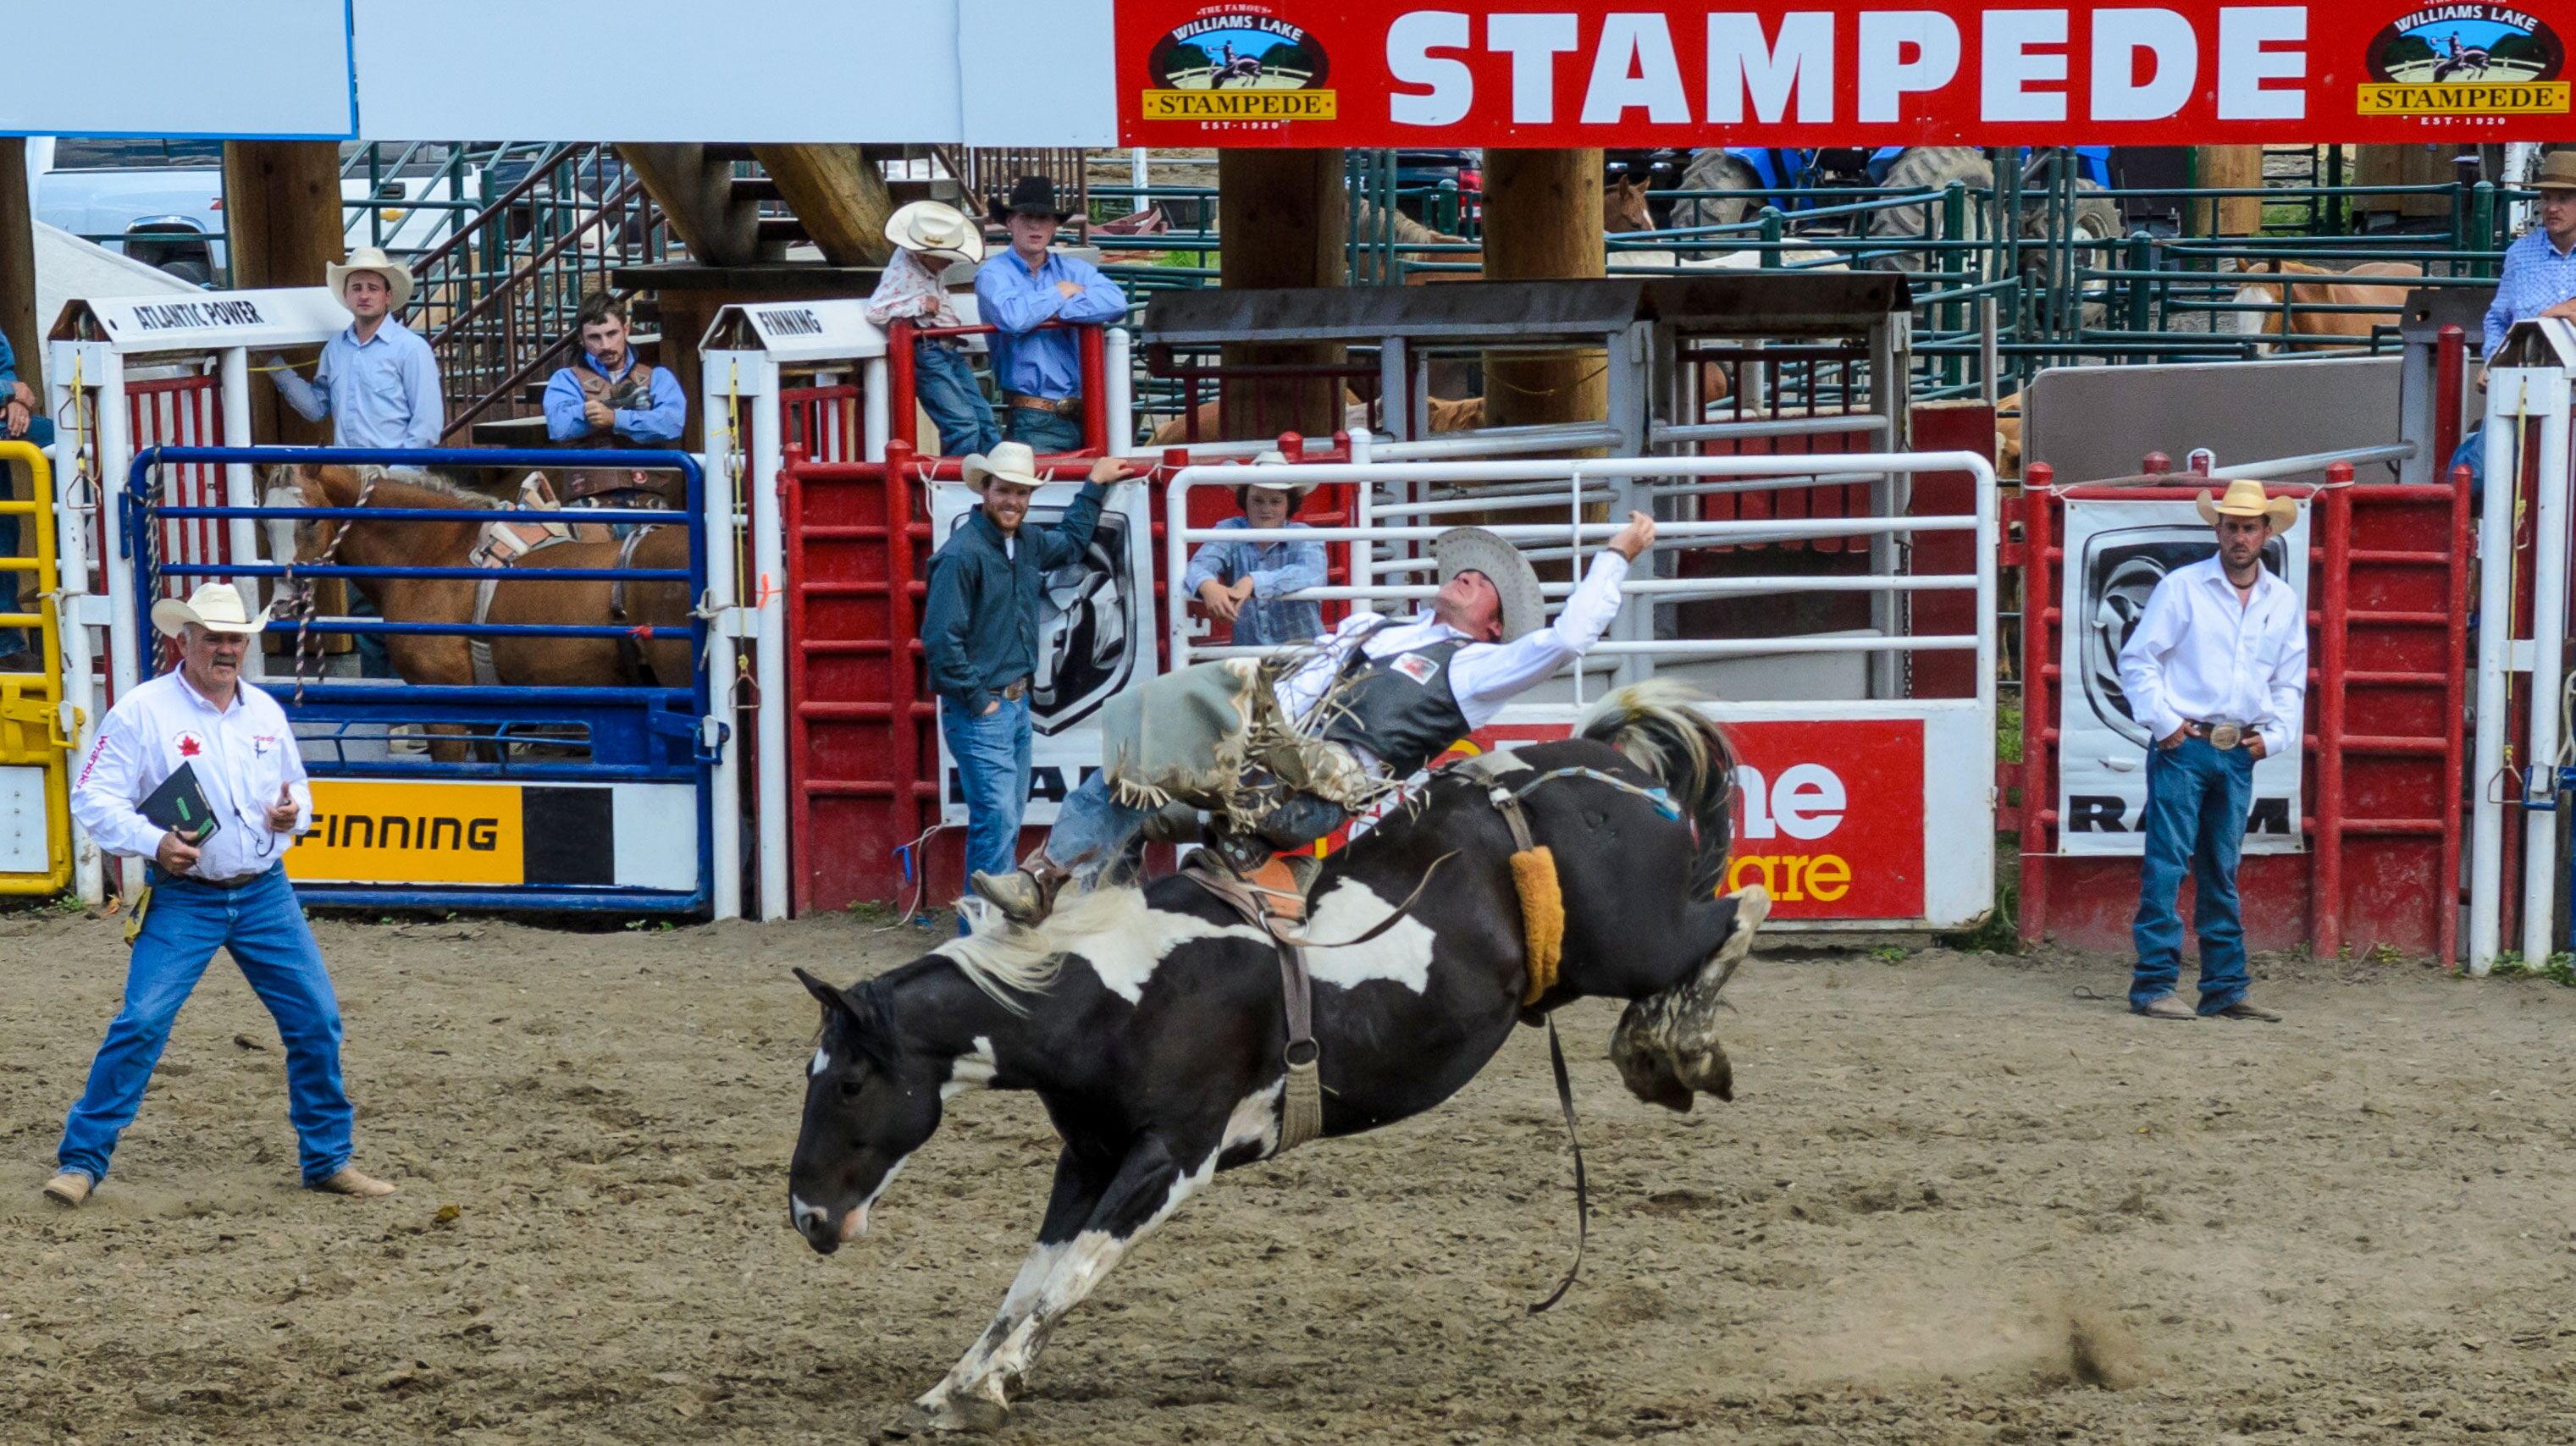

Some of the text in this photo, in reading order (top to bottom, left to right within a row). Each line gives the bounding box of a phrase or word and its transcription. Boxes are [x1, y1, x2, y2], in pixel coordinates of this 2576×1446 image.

[1224, 3, 1269, 14] FAMOUS
[2394, 4, 2538, 33] WILLIAMS LAKE
[1172, 15, 1304, 42] WILLIAMS LAKE
[1385, 4, 2308, 127] STAMPEDE
[1159, 95, 1321, 114] STAMPEDE
[2375, 87, 2553, 108] STAMPEDE
[132, 301, 265, 330] ATLANTIC POWER
[755, 308, 823, 336] FINNING
[2069, 795, 2291, 835] RM
[295, 814, 499, 852] FINNING
[1715, 853, 1852, 902] are
